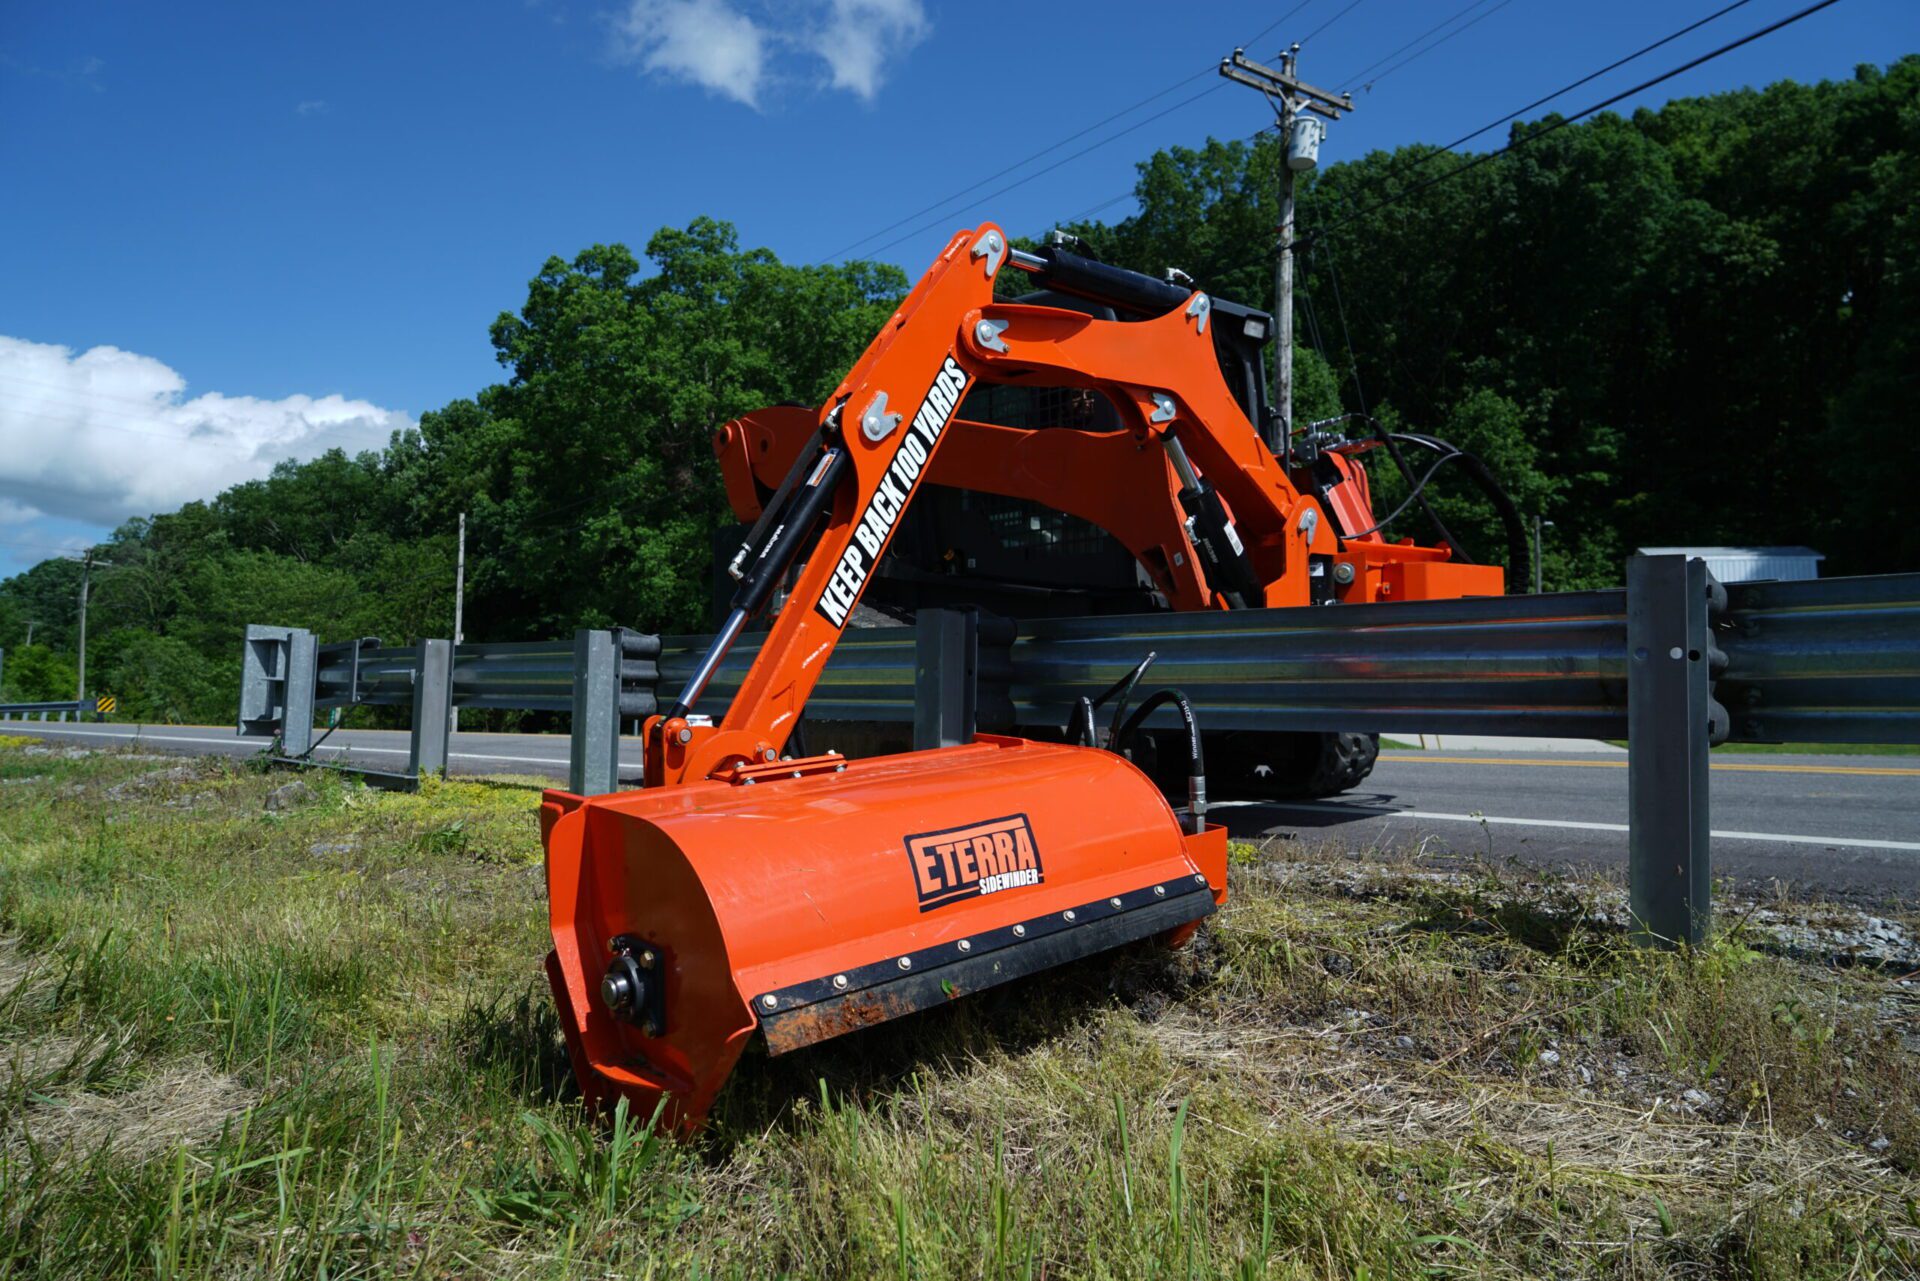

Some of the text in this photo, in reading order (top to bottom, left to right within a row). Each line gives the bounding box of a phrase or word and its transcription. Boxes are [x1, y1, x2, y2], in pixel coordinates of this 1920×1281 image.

[818, 544, 867, 628] KEEP
[854, 471, 906, 559] BACK
[892, 432, 927, 491] 100
[912, 356, 967, 446] YARDS
[909, 824, 1038, 895] ETERRA
[979, 868, 1039, 895] SIDEWINDER
